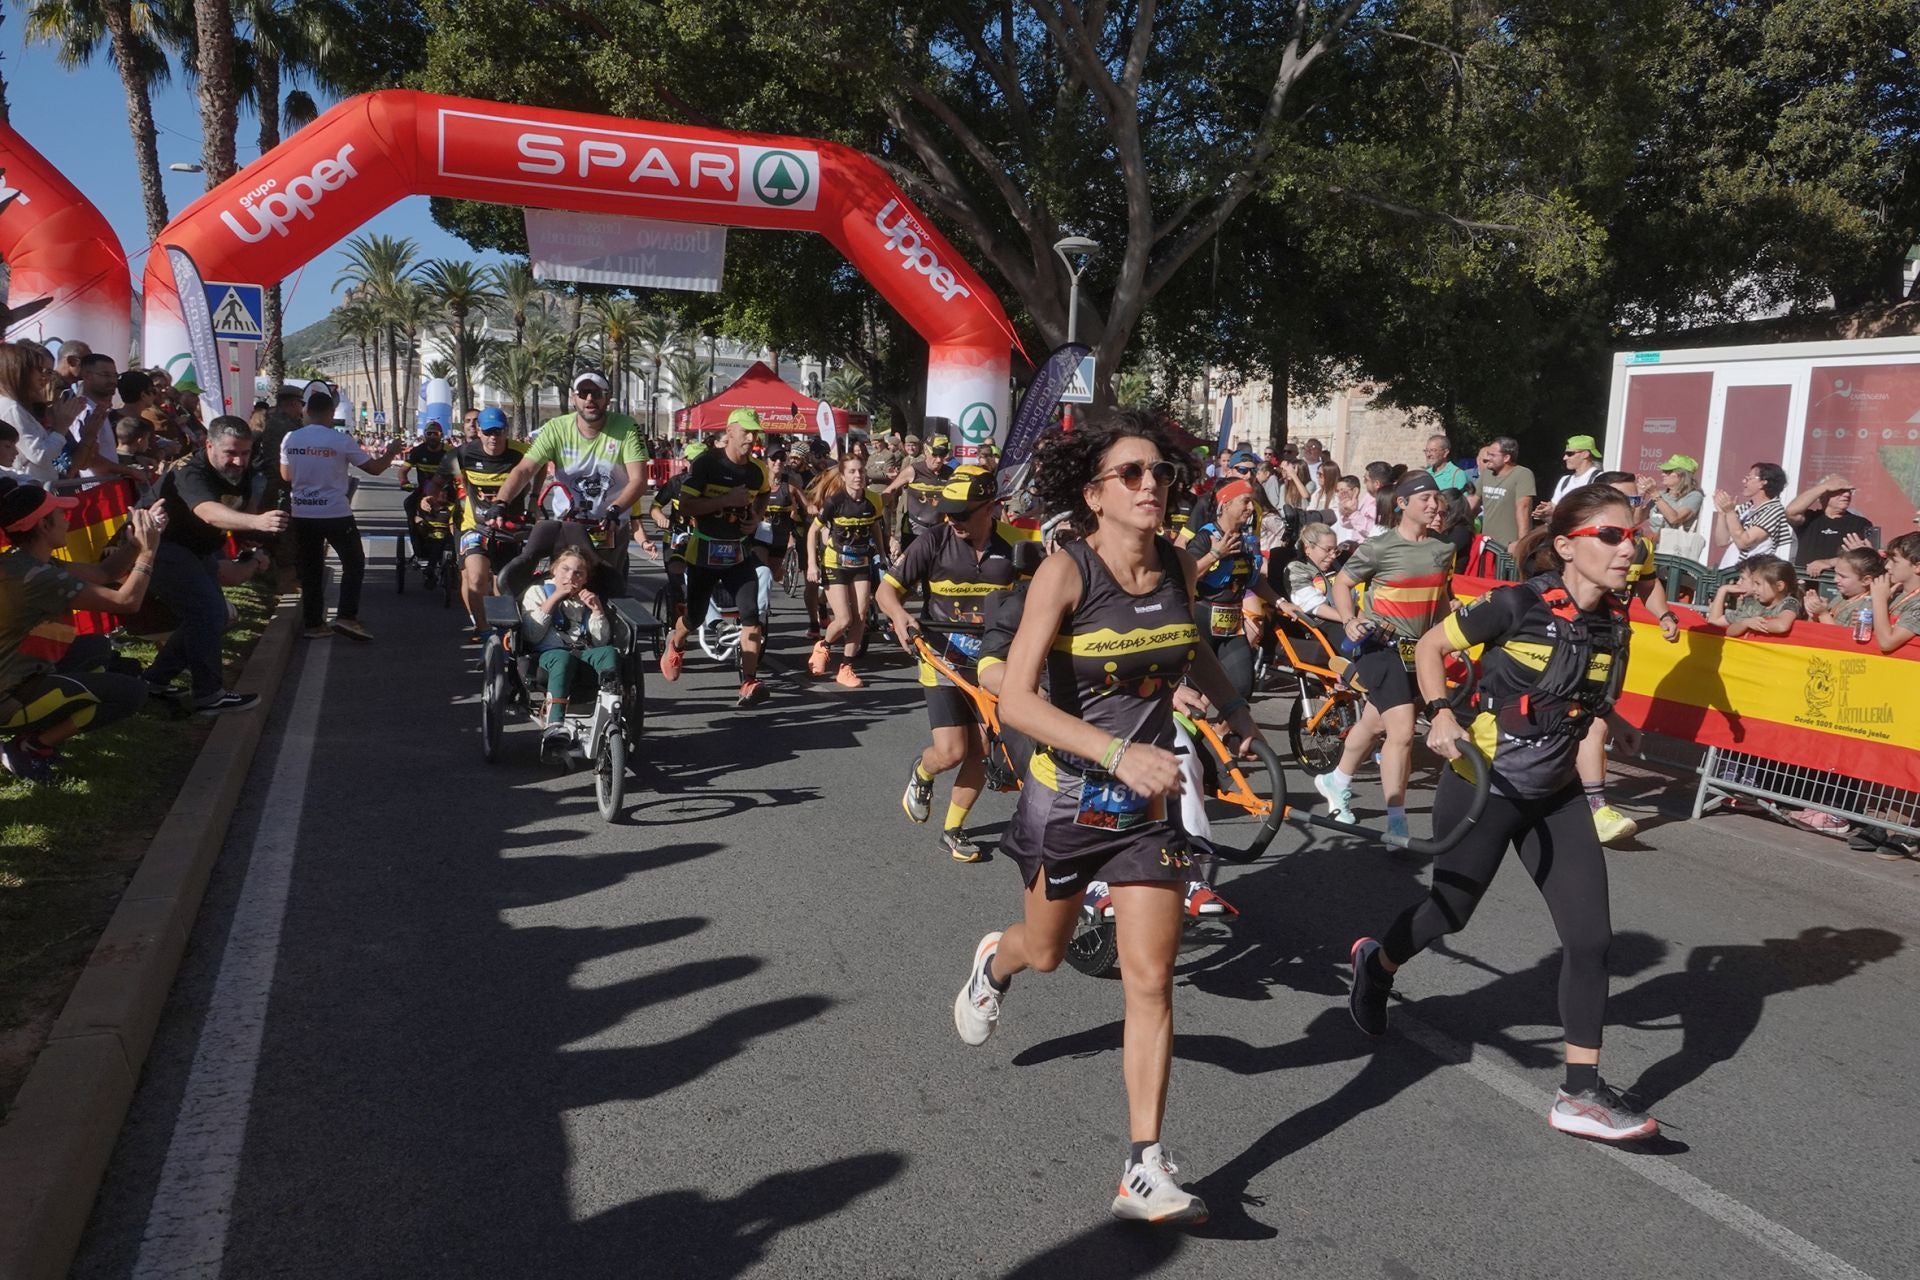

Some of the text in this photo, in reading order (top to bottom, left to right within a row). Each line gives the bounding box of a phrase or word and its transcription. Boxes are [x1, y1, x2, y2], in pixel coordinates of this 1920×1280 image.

[517, 132, 735, 192] SPAR
[239, 178, 277, 208] grupo
[1007, 370, 1048, 457] Ayuntamiento
[1640, 445, 1663, 458] bus
[959, 636, 982, 651] 142
[1084, 637, 1146, 652] ZANCADAS
[1147, 630, 1181, 646] SOBRE
[1840, 658, 1867, 675] CROSS
[1839, 675, 1850, 691] DE
[1838, 691, 1849, 707] LA
[1794, 715, 1814, 725] Desde
[1836, 702, 1895, 724] ARTILLERÍA
